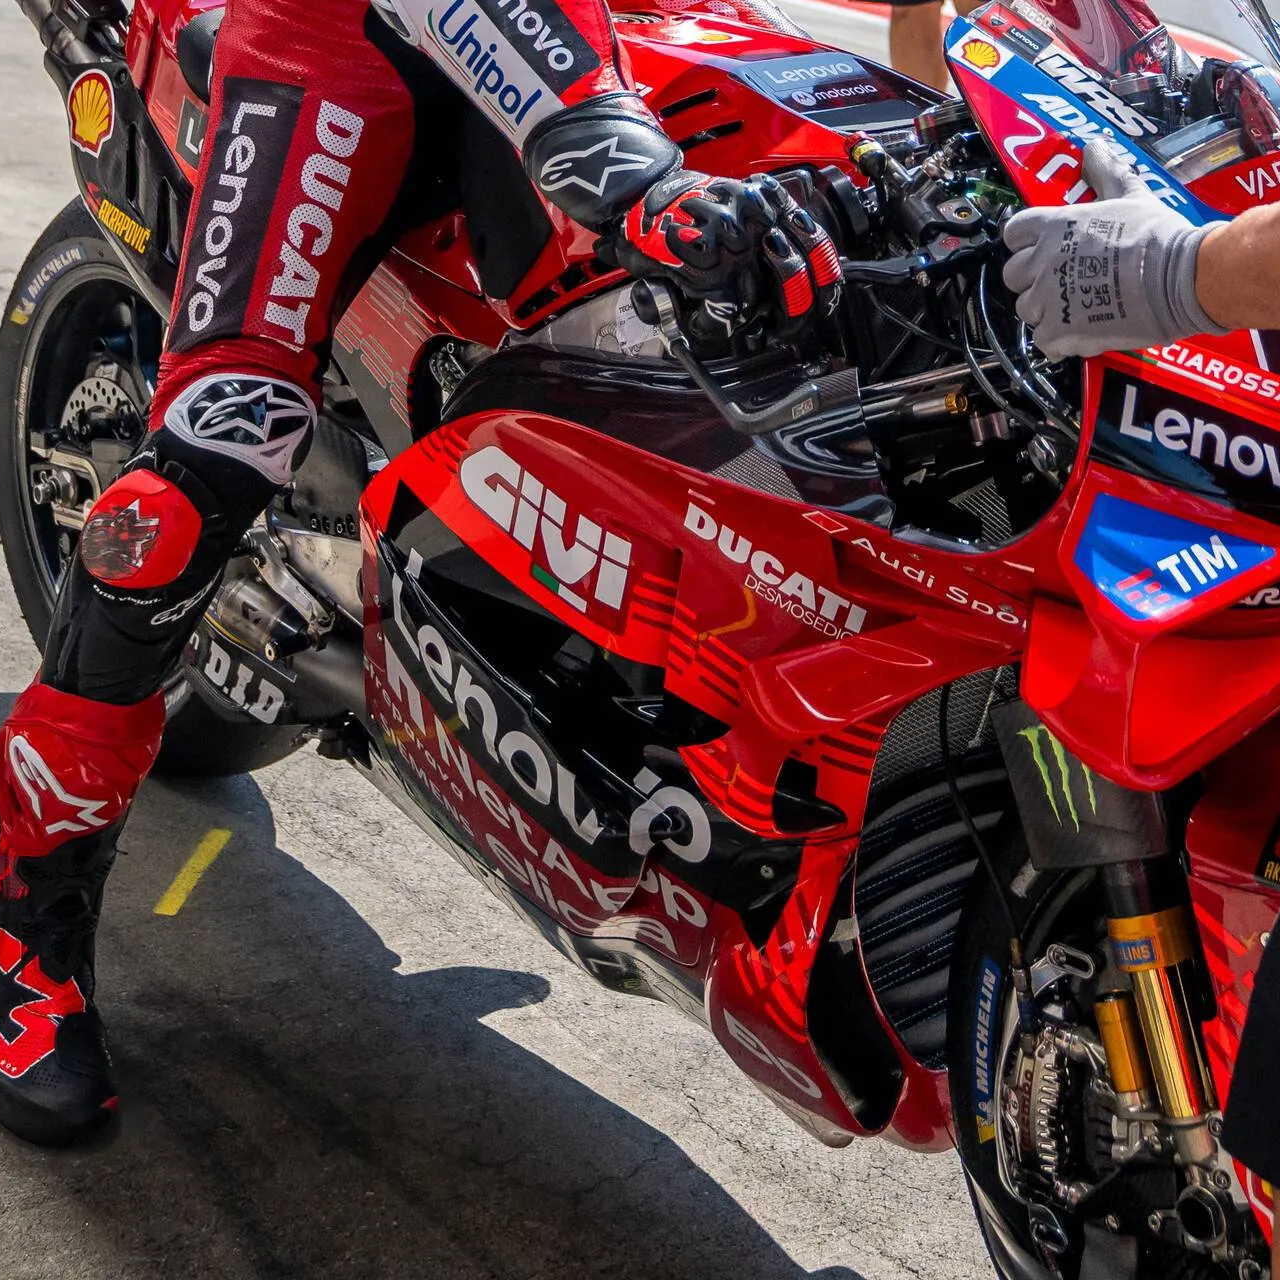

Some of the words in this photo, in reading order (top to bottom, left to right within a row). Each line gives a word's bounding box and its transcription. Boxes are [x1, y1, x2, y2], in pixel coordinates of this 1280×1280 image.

[1010, 27, 1040, 51] Lenovo
[771, 60, 855, 86] Lenovo
[814, 83, 878, 102] motorola
[1035, 54, 1160, 138] WRS
[98, 198, 151, 255] AKRAPOVIČ
[187, 101, 278, 333] Lenovo
[1060, 220, 1077, 254] 551
[28, 246, 83, 300] MICHELIN
[460, 445, 633, 611] GIVI
[683, 501, 868, 634] DUCATI
[850, 537, 936, 590] Audi
[1156, 534, 1238, 594] TIM
[387, 547, 712, 864] Lenovo
[485, 832, 681, 958] elica
[975, 967, 998, 1095] MICHELIN
